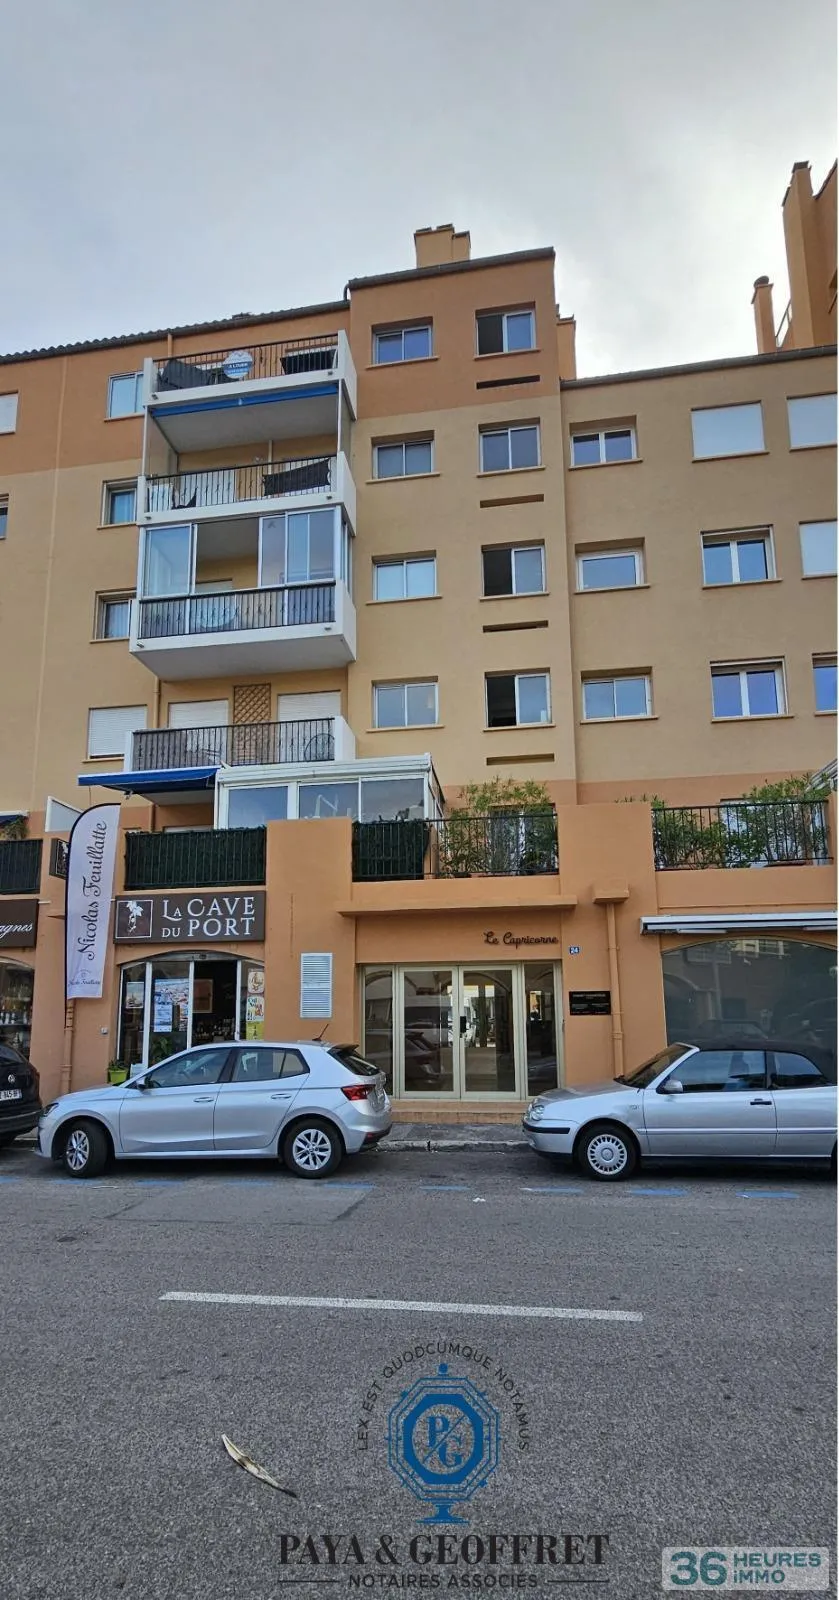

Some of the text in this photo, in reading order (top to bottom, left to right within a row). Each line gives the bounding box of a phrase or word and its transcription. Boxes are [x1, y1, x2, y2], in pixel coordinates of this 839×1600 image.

[77, 821, 107, 961] Nicolas Feuillatte
[187, 896, 255, 917] CAVE
[161, 917, 255, 938] DU PORT
[483, 931, 559, 950] Le Capricorne
